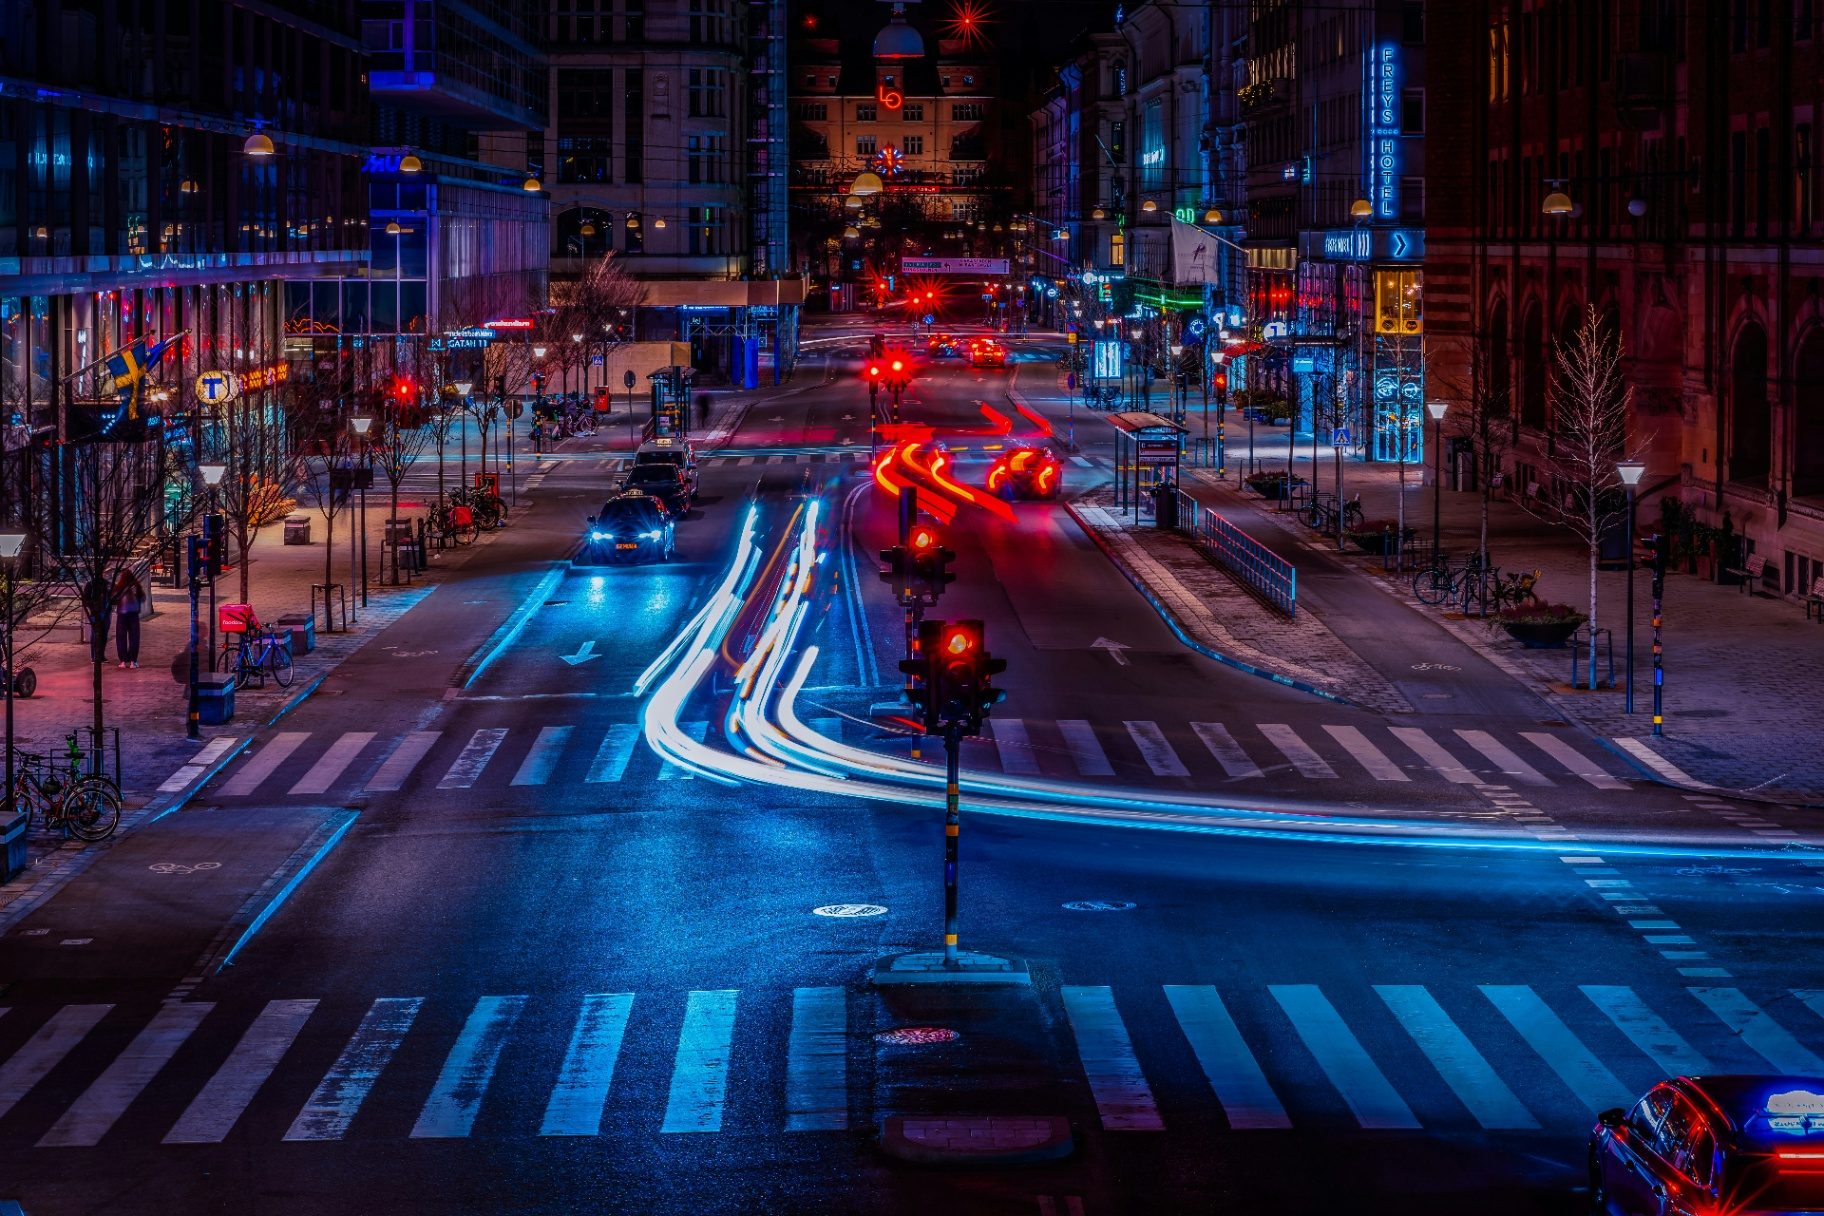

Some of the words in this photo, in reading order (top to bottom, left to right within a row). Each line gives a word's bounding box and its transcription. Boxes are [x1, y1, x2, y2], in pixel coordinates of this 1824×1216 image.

[1381, 48, 1395, 123] FREYS
[1380, 140, 1394, 215] HOTEL
[202, 378, 222, 399] T
